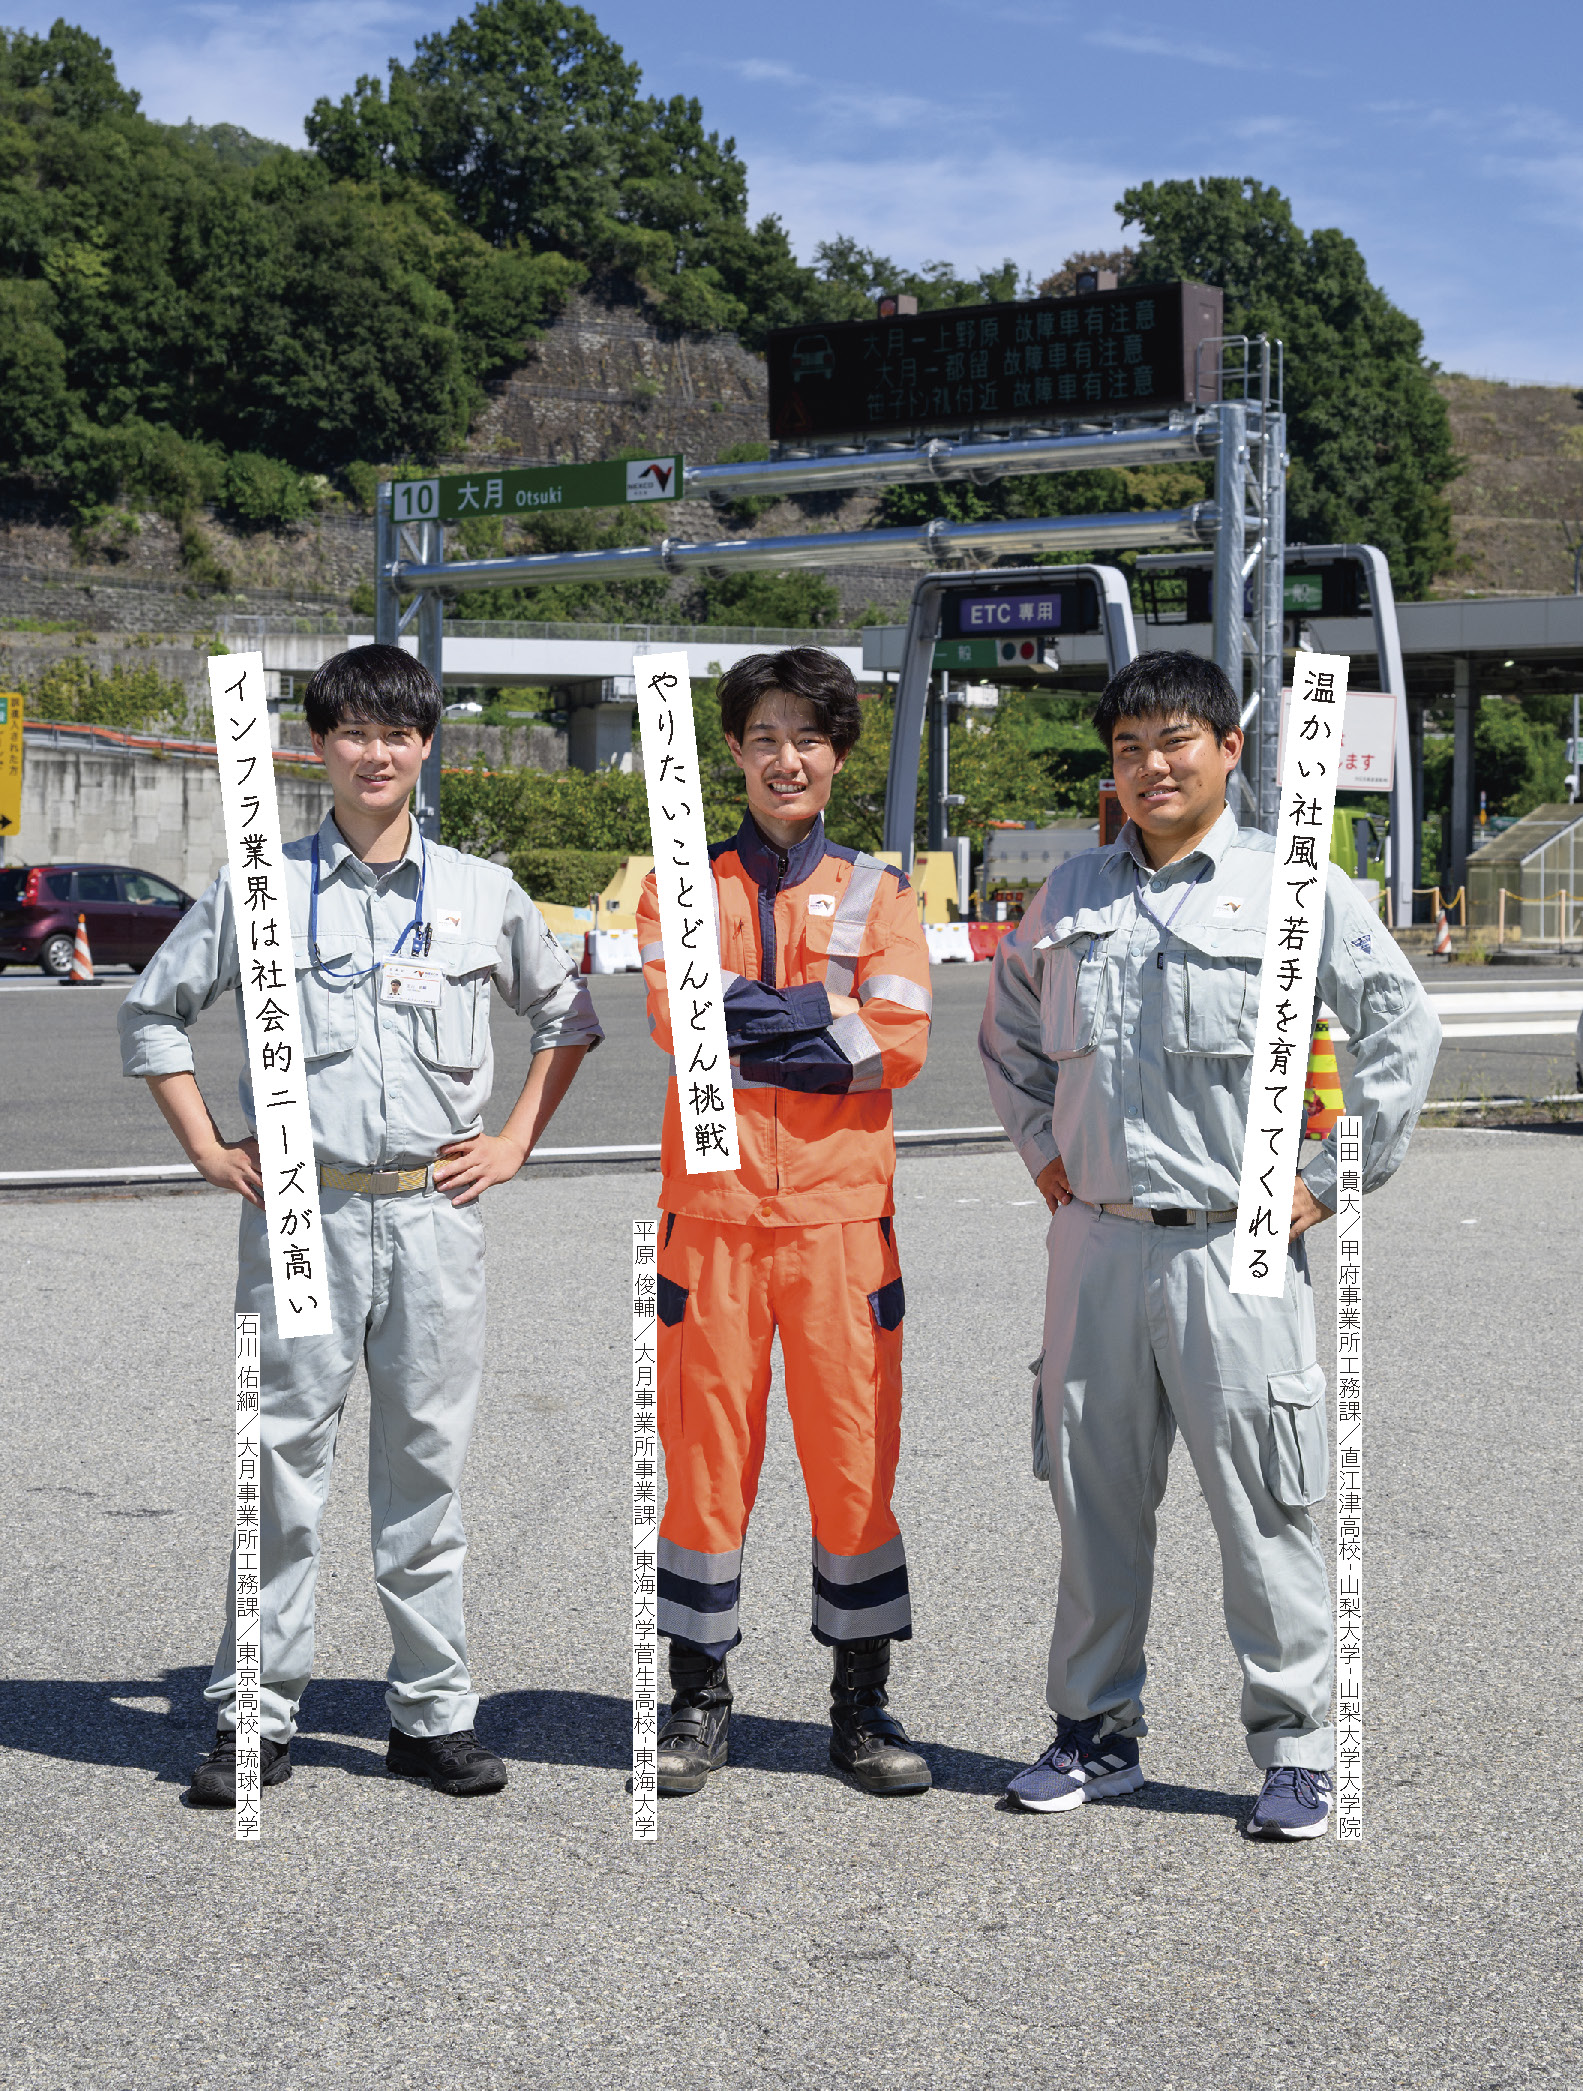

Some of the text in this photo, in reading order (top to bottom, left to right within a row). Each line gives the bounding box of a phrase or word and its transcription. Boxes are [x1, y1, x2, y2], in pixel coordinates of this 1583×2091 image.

[1016, 300, 1156, 343] 故障車有注意
[1004, 334, 1143, 375] 故障車有注意
[1013, 365, 1154, 408] 故障車有注意
[401, 484, 433, 515] 10
[458, 479, 562, 511] 大月 Otsuki
[971, 602, 1053, 624] ETC 専用
